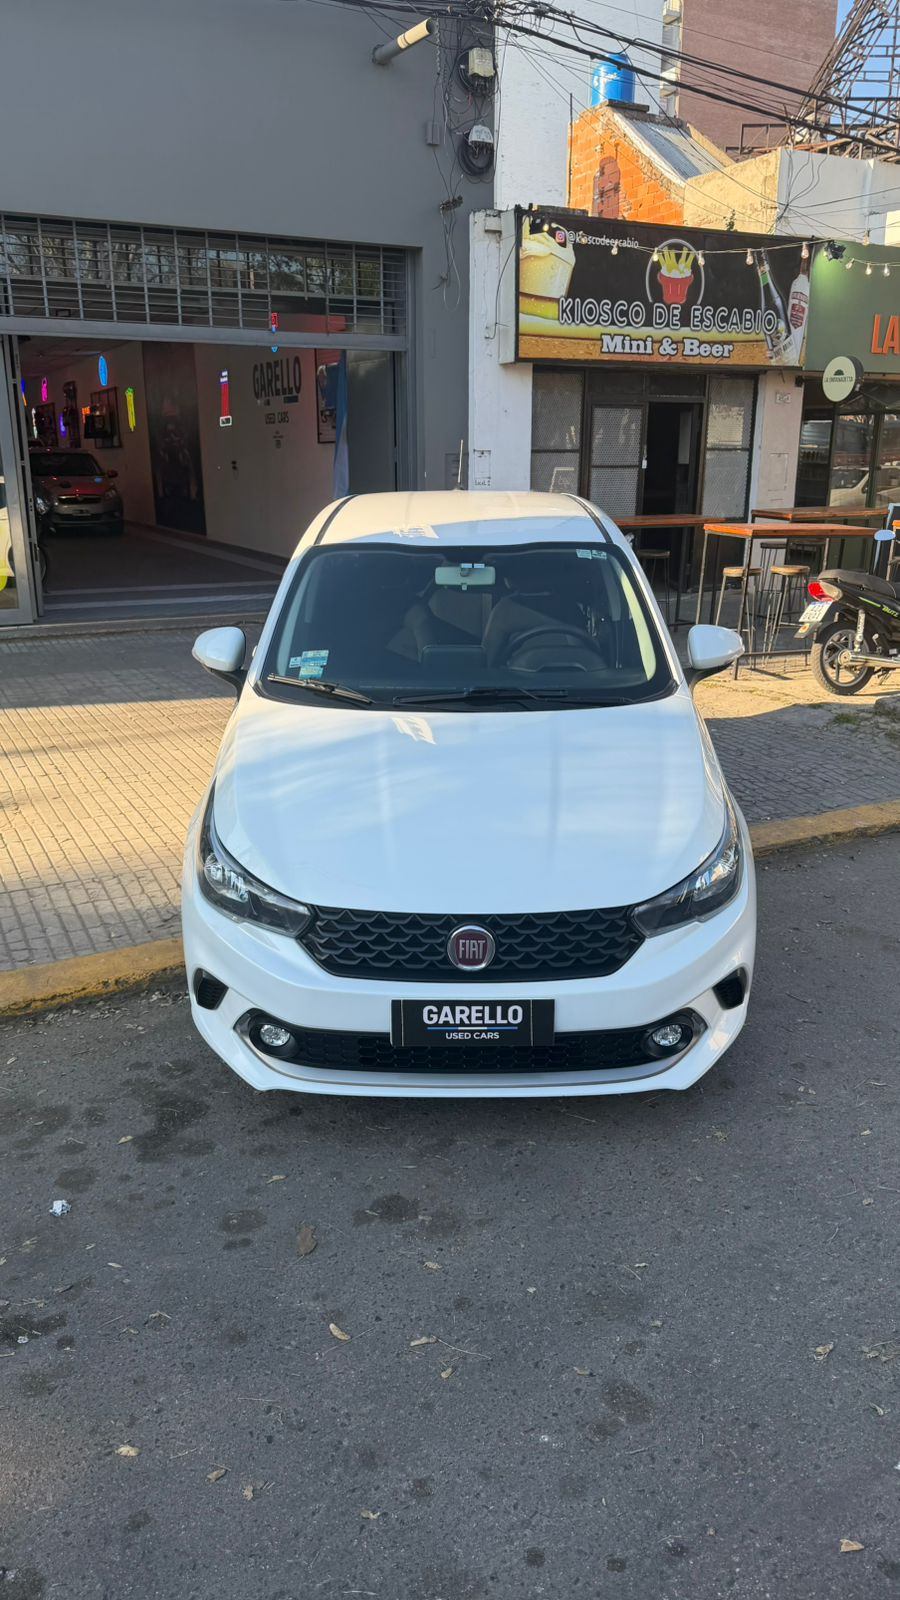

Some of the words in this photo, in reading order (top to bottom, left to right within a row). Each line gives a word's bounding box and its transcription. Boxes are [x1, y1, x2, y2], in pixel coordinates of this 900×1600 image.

[568, 230, 639, 249] @koscodeecabio
[558, 297, 646, 328] KIOSCO
[652, 303, 682, 329] DE
[690, 305, 778, 334] ESCABIO
[871, 313, 900, 354] LA
[601, 335, 653, 356] Mini
[658, 339, 678, 357] &
[682, 337, 734, 358] Beer
[253, 355, 302, 399] GARELLO
[265, 412, 276, 424] USED
[277, 411, 289, 424] CARS
[459, 939, 486, 960] FIAT
[422, 1005, 523, 1025] GARELLO
[446, 1032, 472, 1040] USED
[473, 1032, 500, 1040] CARS
